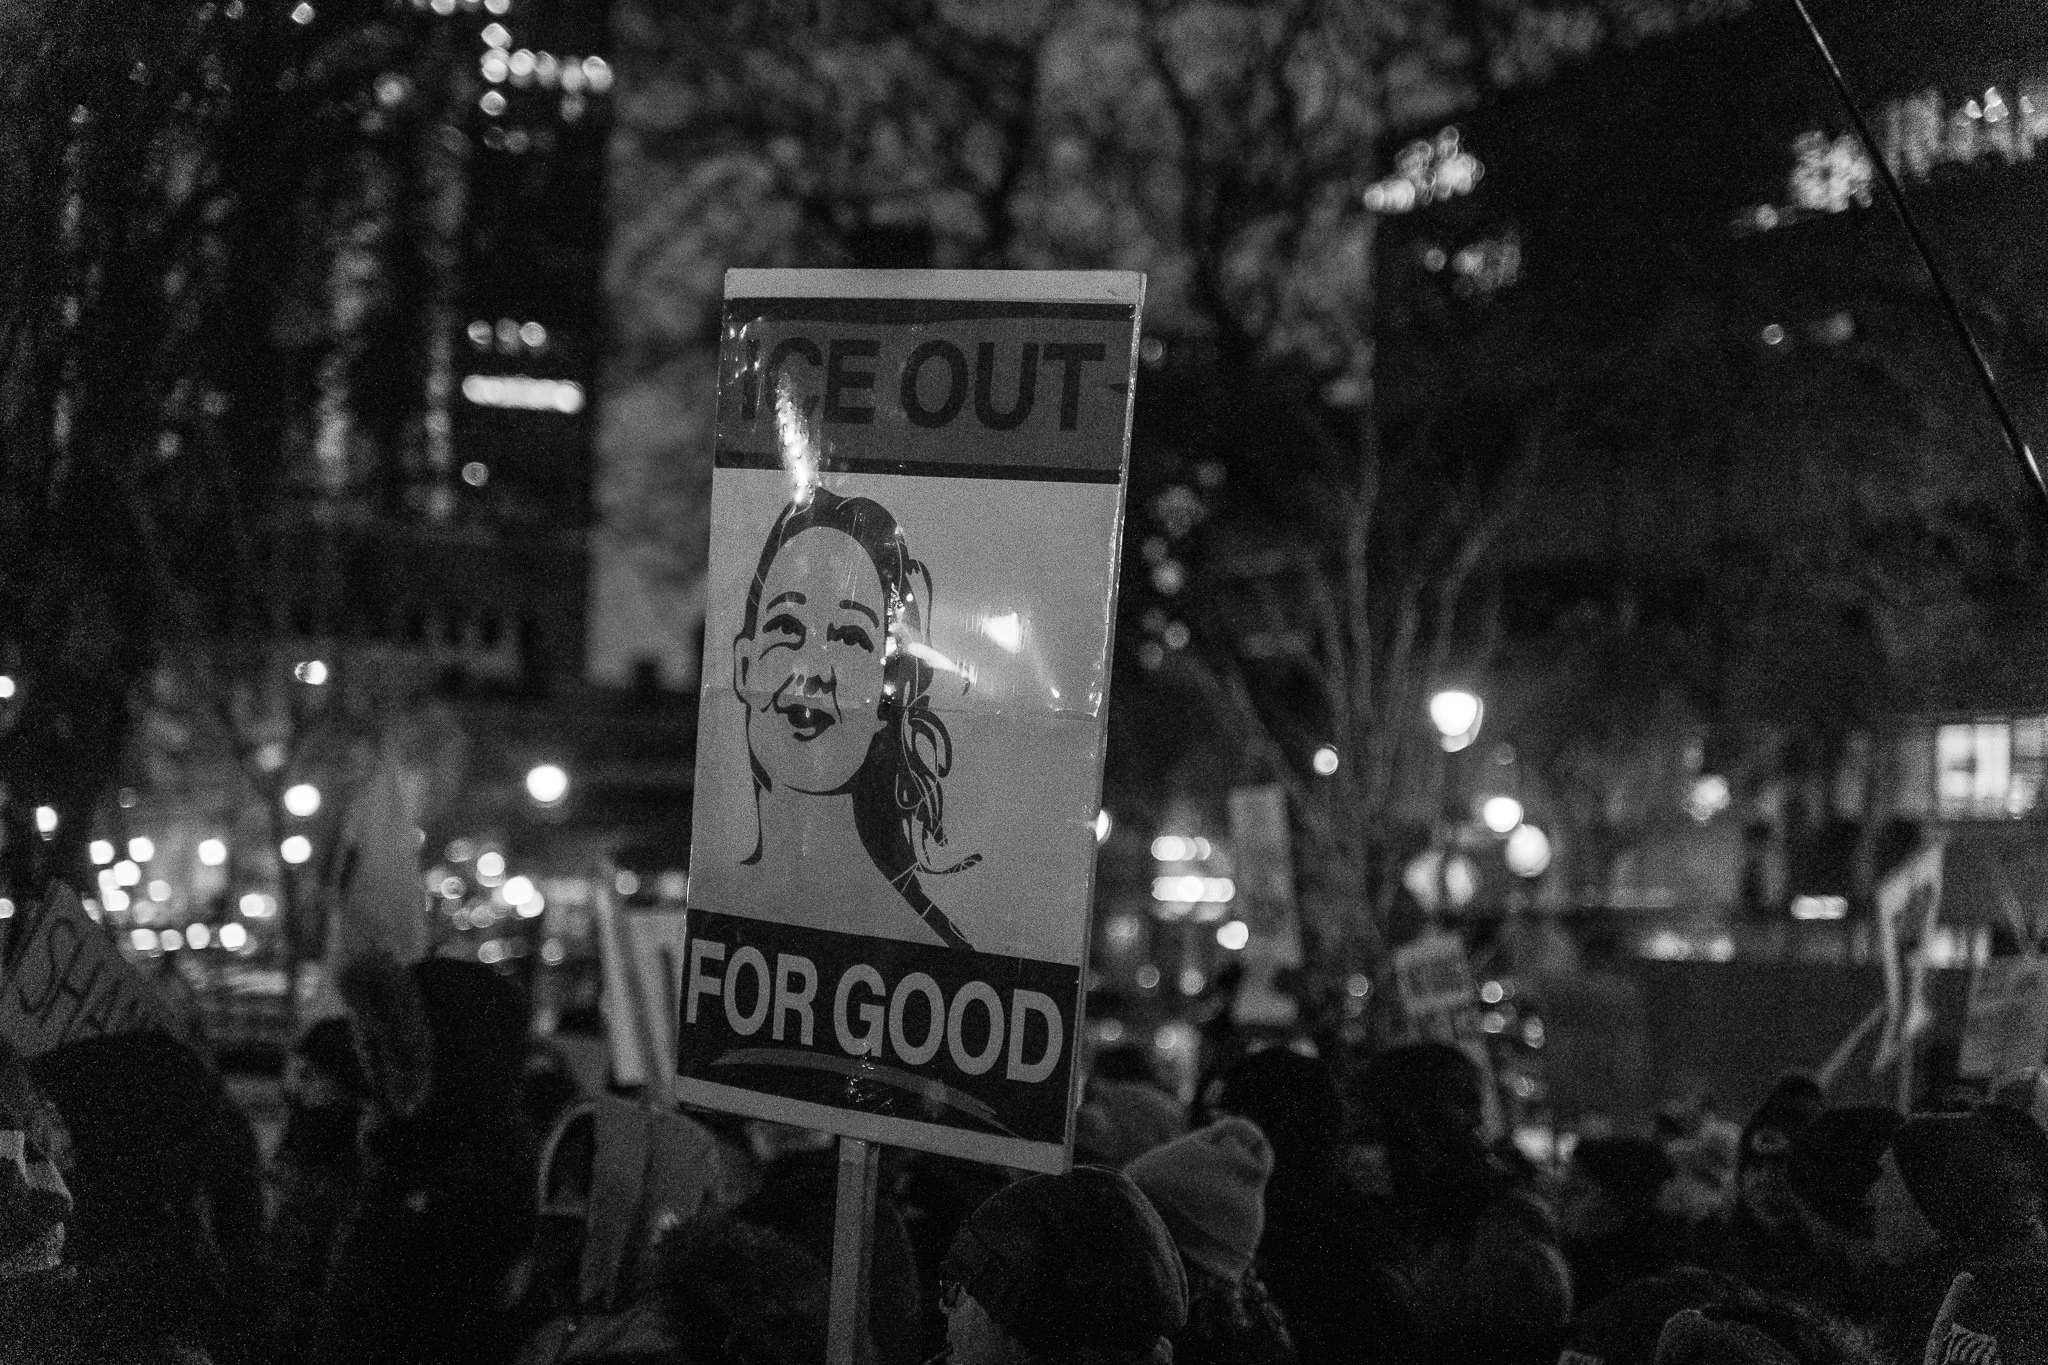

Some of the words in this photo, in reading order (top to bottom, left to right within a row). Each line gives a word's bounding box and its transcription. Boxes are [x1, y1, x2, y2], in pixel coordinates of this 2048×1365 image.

[740, 338, 880, 424] ICE
[900, 339, 1106, 431] OUT
[687, 938, 818, 1046] FOR
[833, 963, 1063, 1085] GOOD
